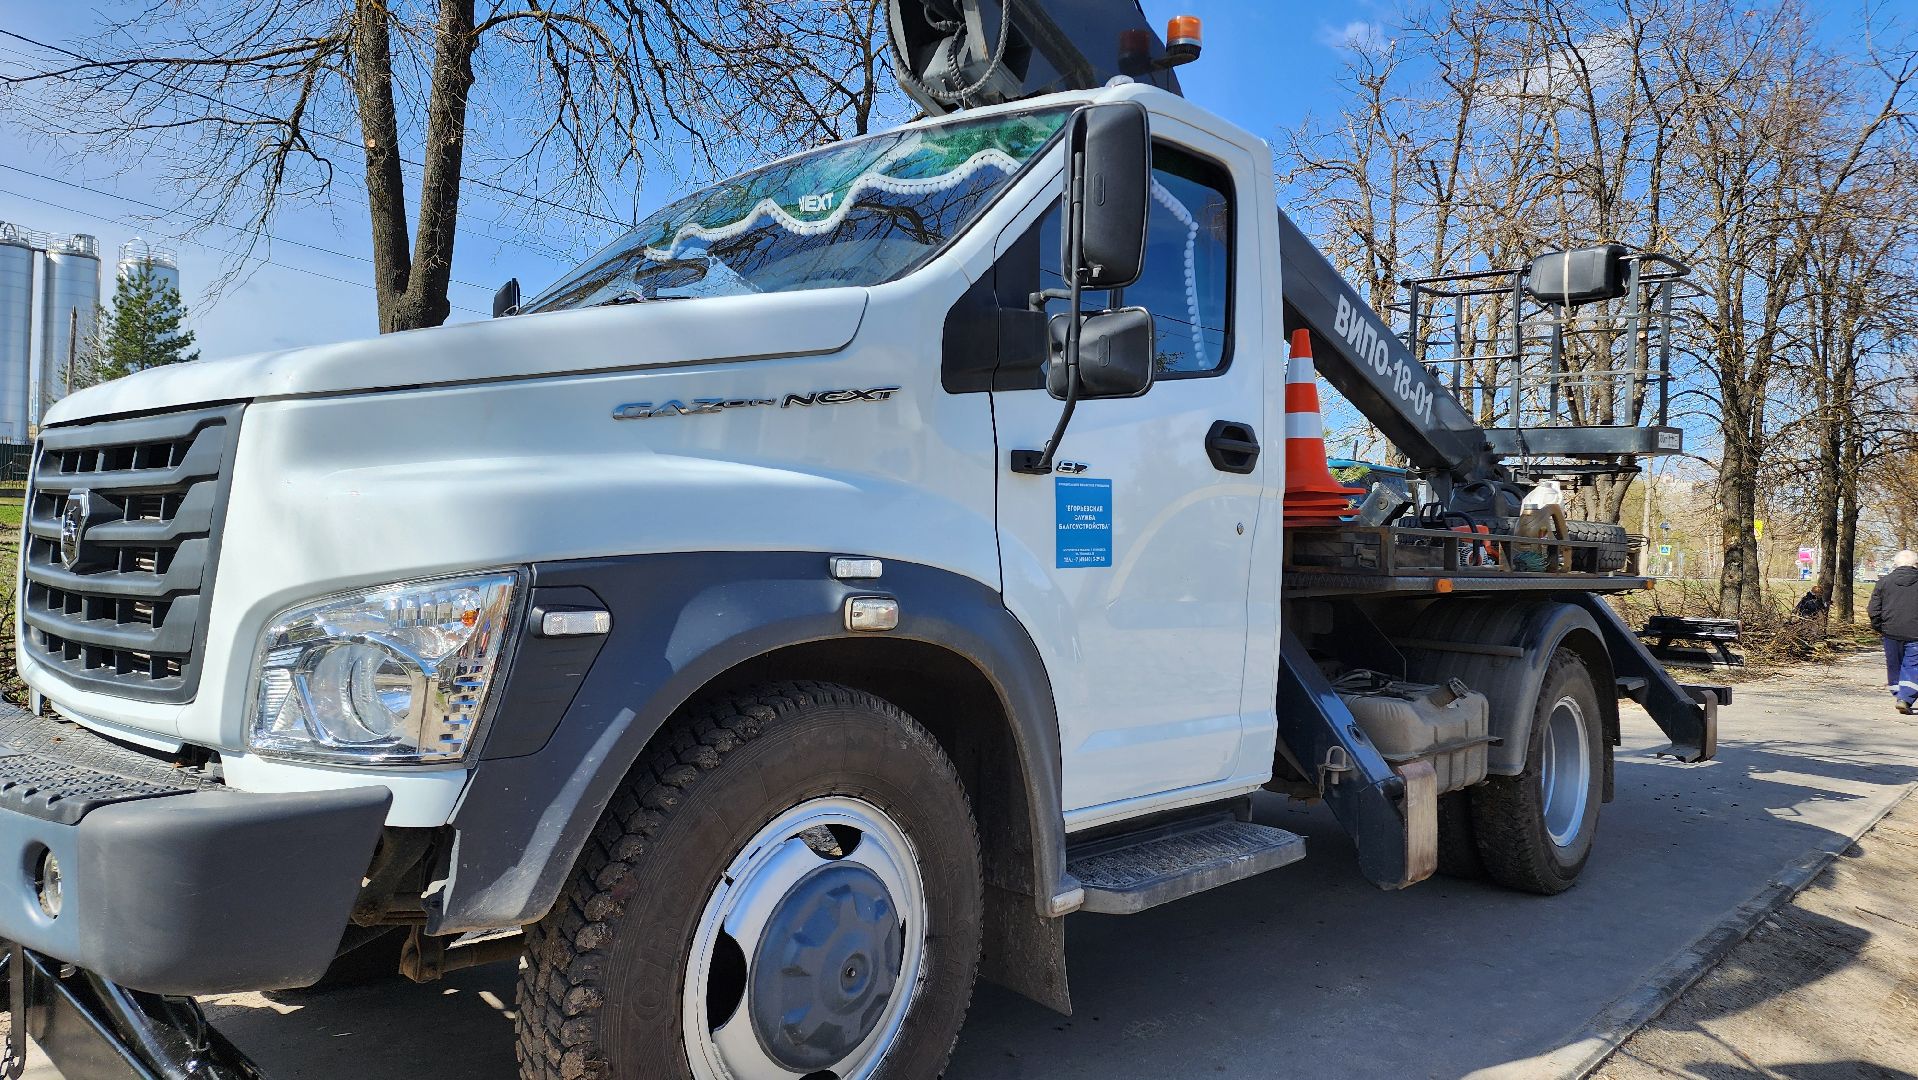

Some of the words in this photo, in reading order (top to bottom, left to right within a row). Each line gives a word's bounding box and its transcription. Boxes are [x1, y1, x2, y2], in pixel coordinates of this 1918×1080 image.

[798, 192, 834, 212] NEXT
[1334, 294, 1434, 425] ВИПО-18-01
[781, 387, 902, 409] NEXT
